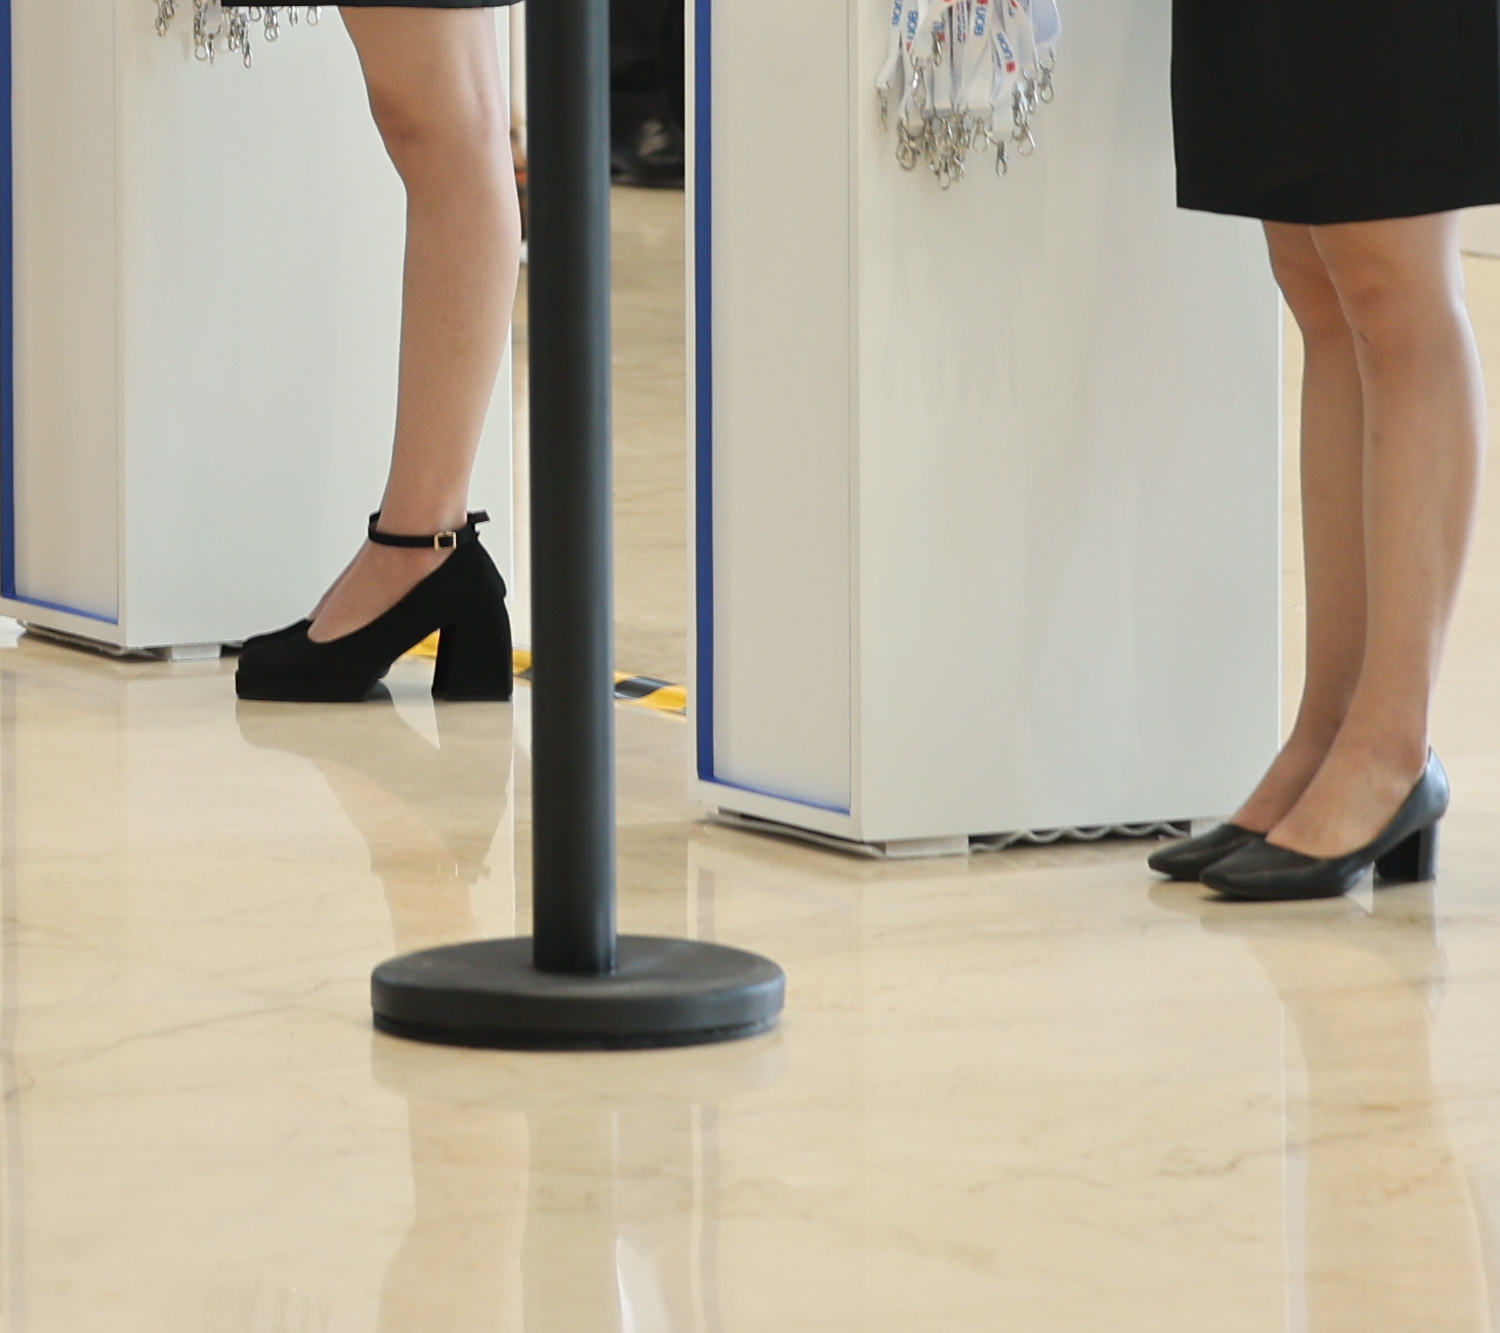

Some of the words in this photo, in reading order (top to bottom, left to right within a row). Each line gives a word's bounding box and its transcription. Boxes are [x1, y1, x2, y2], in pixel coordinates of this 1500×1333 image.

[907, 9, 919, 41] UOB
[974, 7, 987, 37] UOB
[996, 32, 1014, 60] UOB
